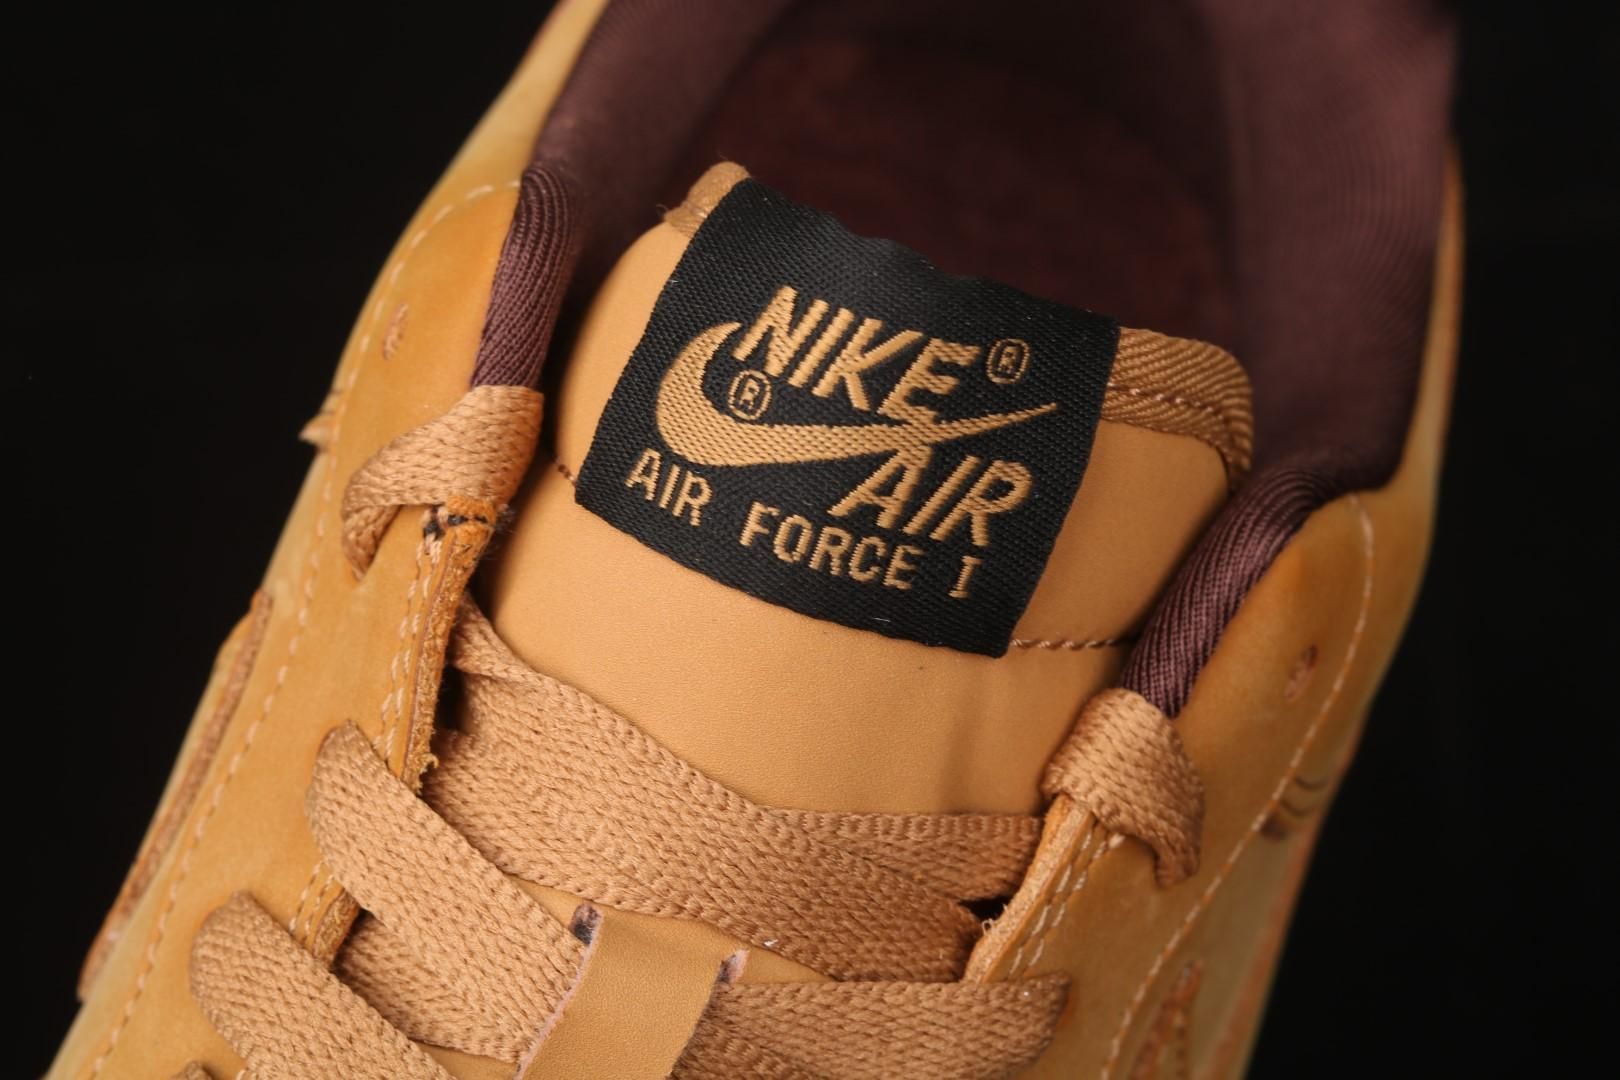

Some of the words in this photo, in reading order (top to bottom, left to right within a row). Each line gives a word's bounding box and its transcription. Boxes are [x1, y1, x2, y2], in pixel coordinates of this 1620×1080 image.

[733, 286, 981, 423] NIKE
[625, 449, 712, 525] AIR
[739, 502, 924, 591] FORCE
[827, 444, 1034, 547] AIR
